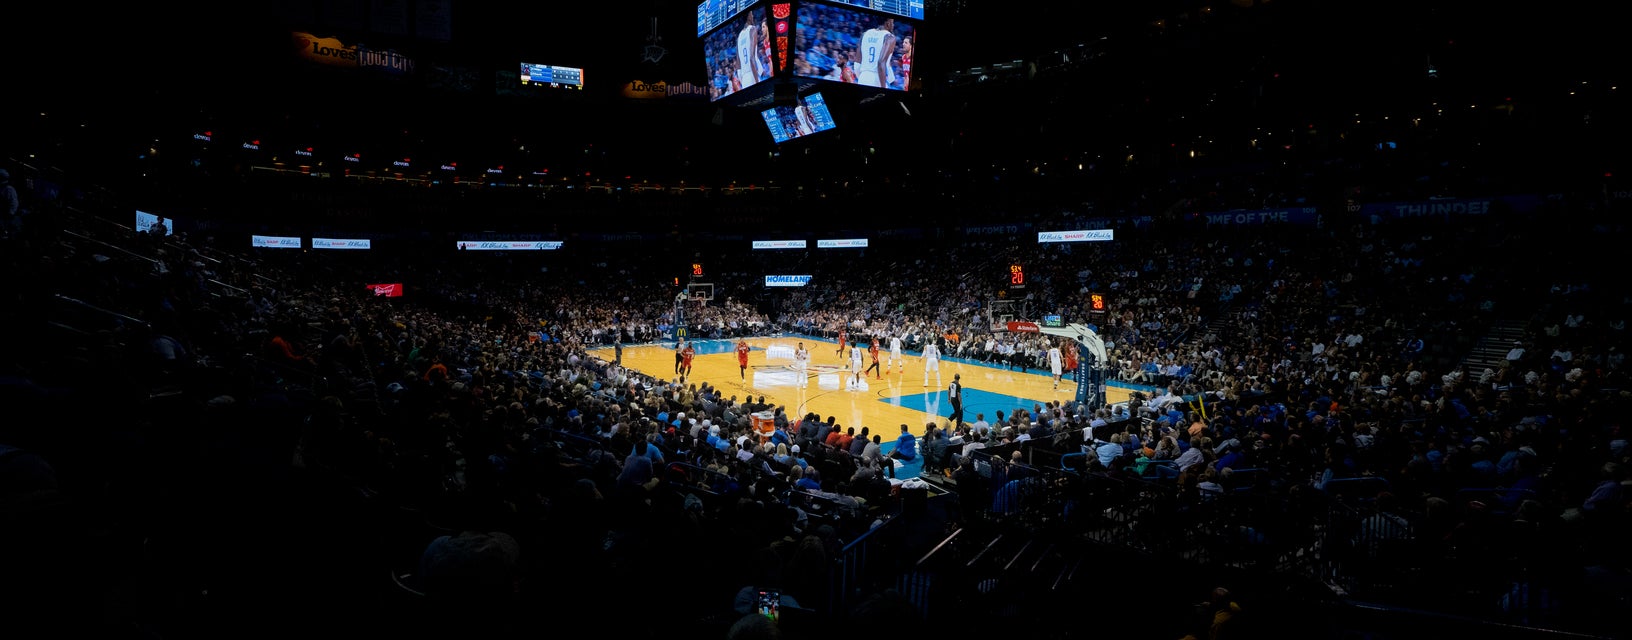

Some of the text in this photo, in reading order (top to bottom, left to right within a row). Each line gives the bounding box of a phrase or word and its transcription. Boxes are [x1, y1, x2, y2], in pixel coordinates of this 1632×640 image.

[868, 46, 876, 63] 9
[632, 81, 665, 93] Loves
[1012, 272, 1023, 284] 20
